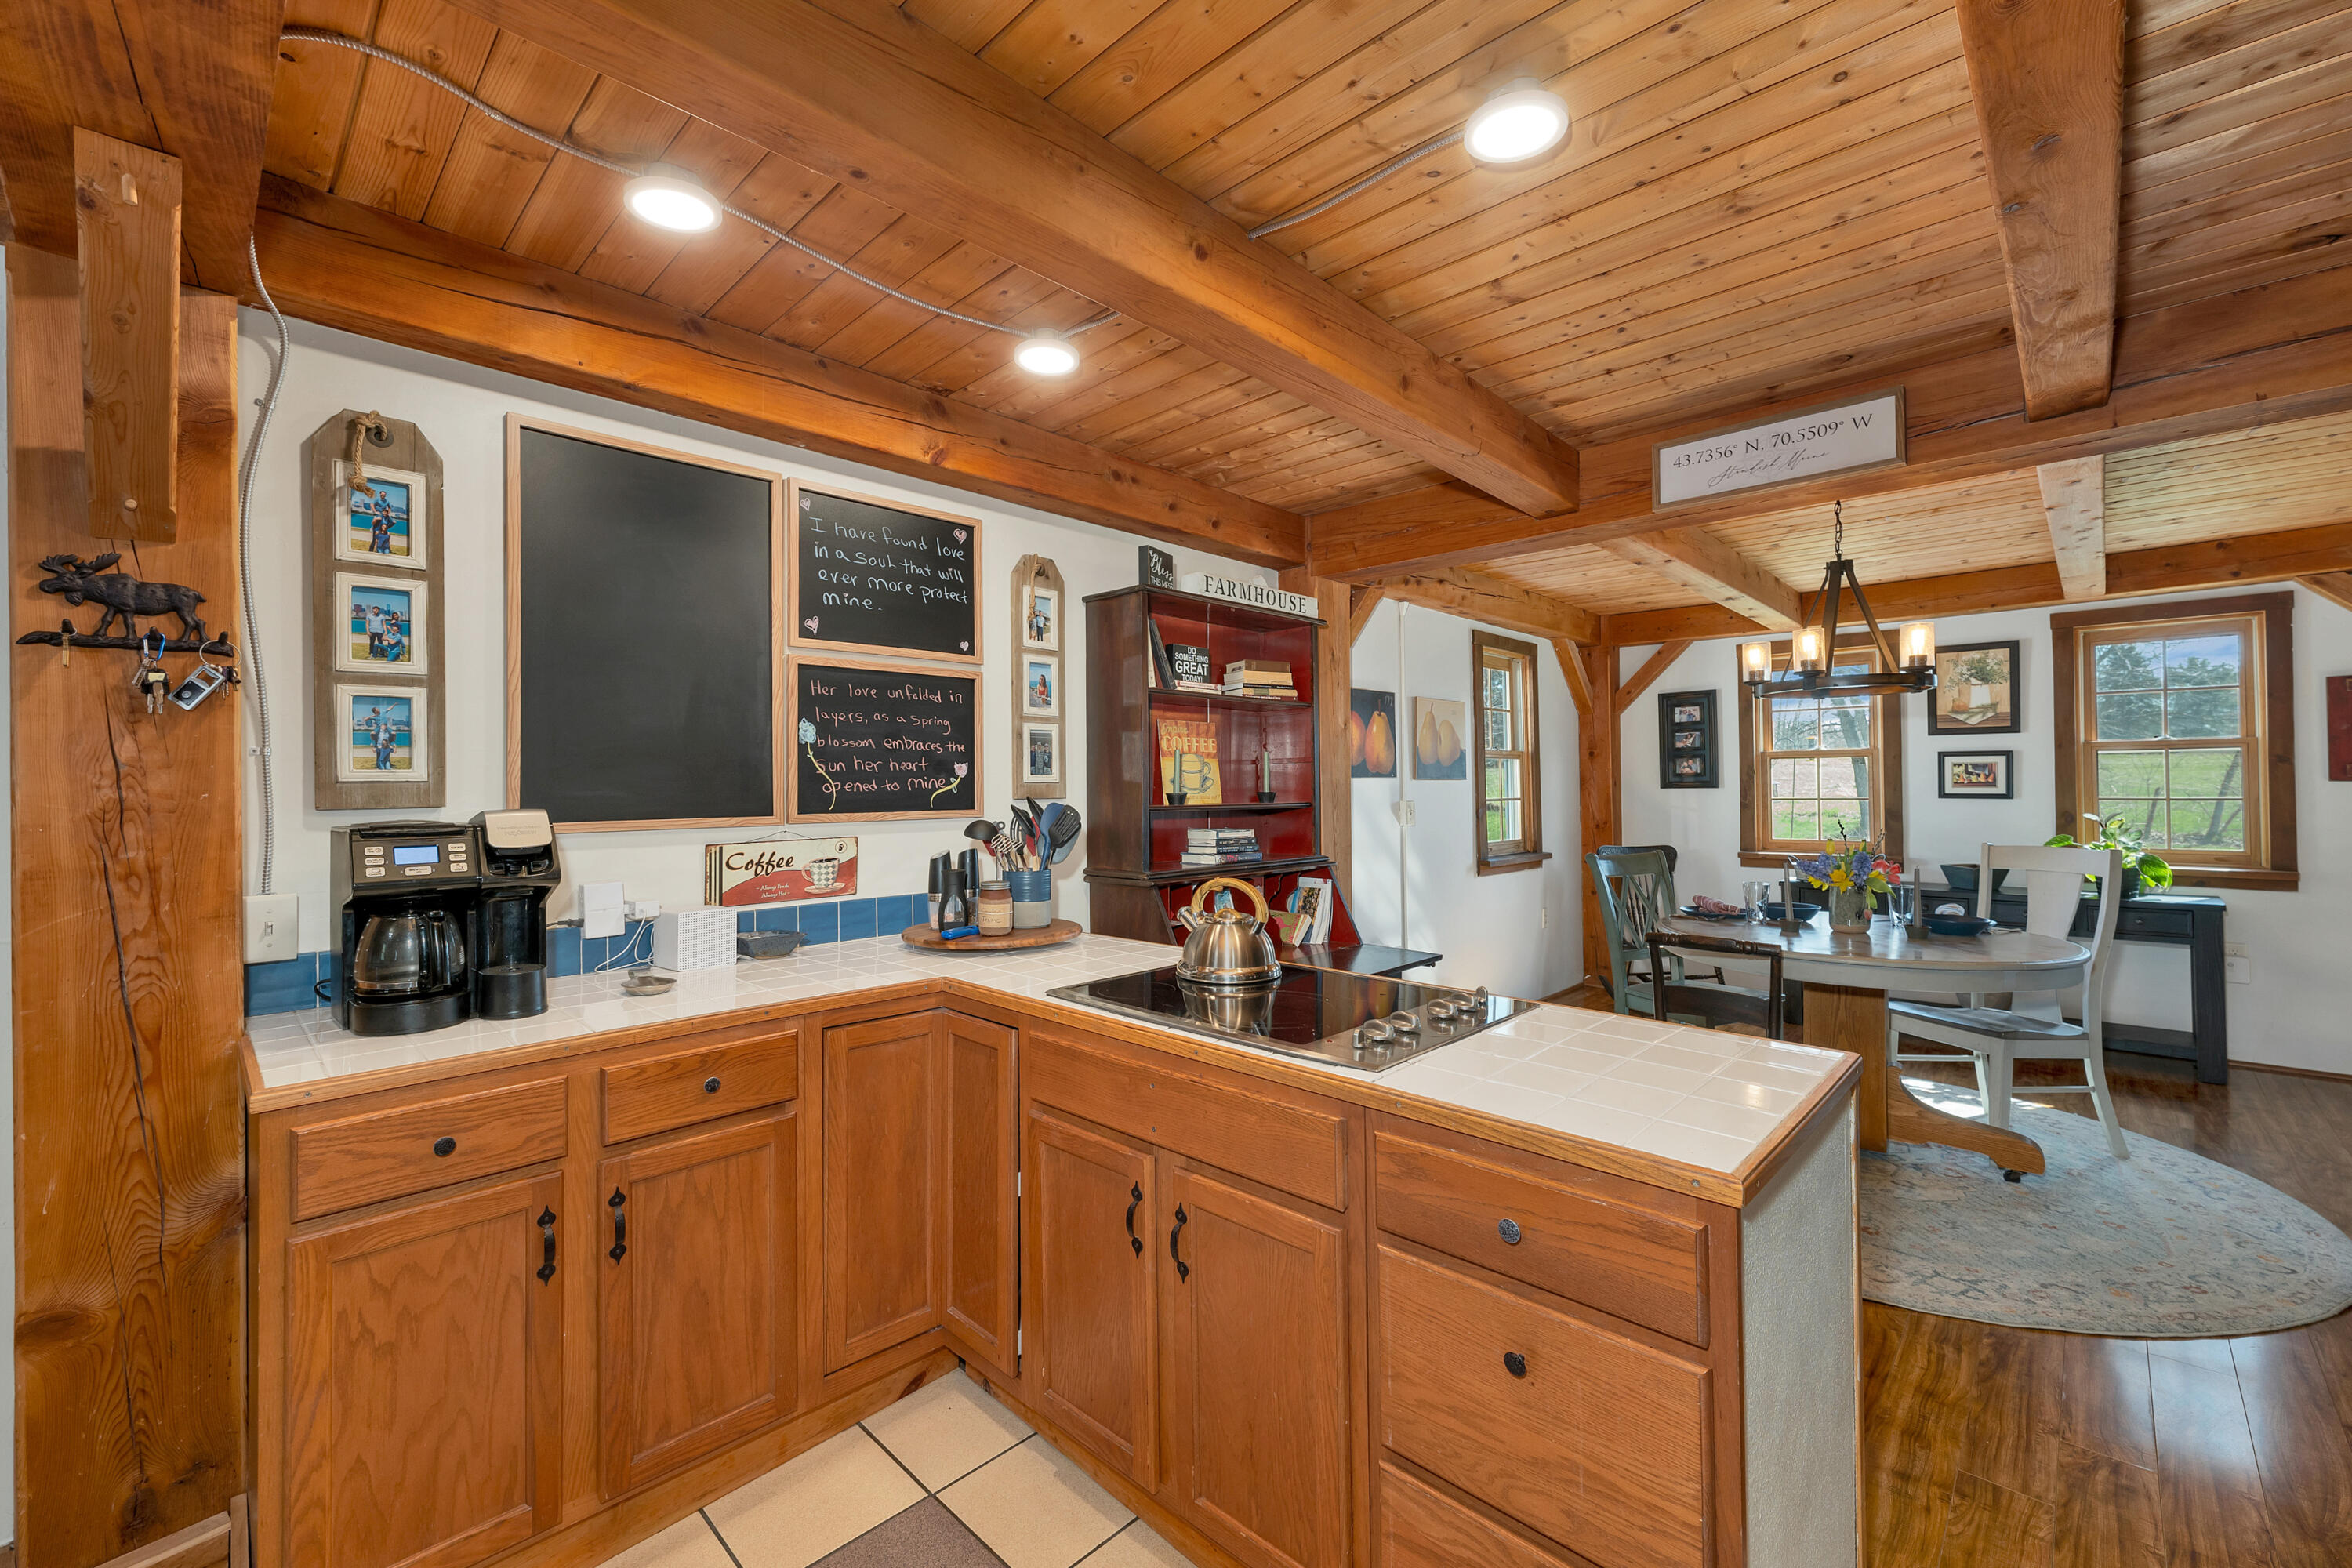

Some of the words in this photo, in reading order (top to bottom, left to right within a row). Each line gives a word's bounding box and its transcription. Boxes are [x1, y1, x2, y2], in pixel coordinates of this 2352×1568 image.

[1673, 444, 1738, 469] 43.7356°
[1770, 420, 1846, 448] 70.5509°
[1851, 413, 1873, 430] W
[809, 517, 828, 533] I
[834, 522, 877, 542] have
[882, 526, 927, 550] found
[936, 537, 966, 561] love
[815, 541, 829, 559] in
[836, 550, 851, 563] a
[900, 559, 931, 577] that
[938, 568, 964, 583] will
[818, 568, 858, 587] ever
[868, 576, 914, 595] more
[919, 586, 969, 604] protect
[1151, 575, 1162, 586] THIS
[1203, 575, 1307, 614] FARMHOUSE
[1174, 652, 1209, 663] SOMETHING
[1187, 646, 1196, 655] DO
[1175, 660, 1209, 676] GREAT
[810, 679, 838, 696] Her
[848, 683, 877, 699] love
[887, 684, 942, 703] unfolded
[949, 690, 963, 704] in
[815, 706, 869, 728] layers,
[873, 712, 889, 722] as
[896, 714, 906, 723] a
[816, 734, 876, 749] blossom
[884, 735, 943, 753] embraces
[944, 741, 966, 753] the
[1161, 735, 1218, 753] COFFEE
[853, 755, 884, 772] her
[890, 757, 929, 772] heart
[822, 780, 877, 793] opened
[881, 780, 900, 792] to
[725, 851, 793, 877] Coffee
